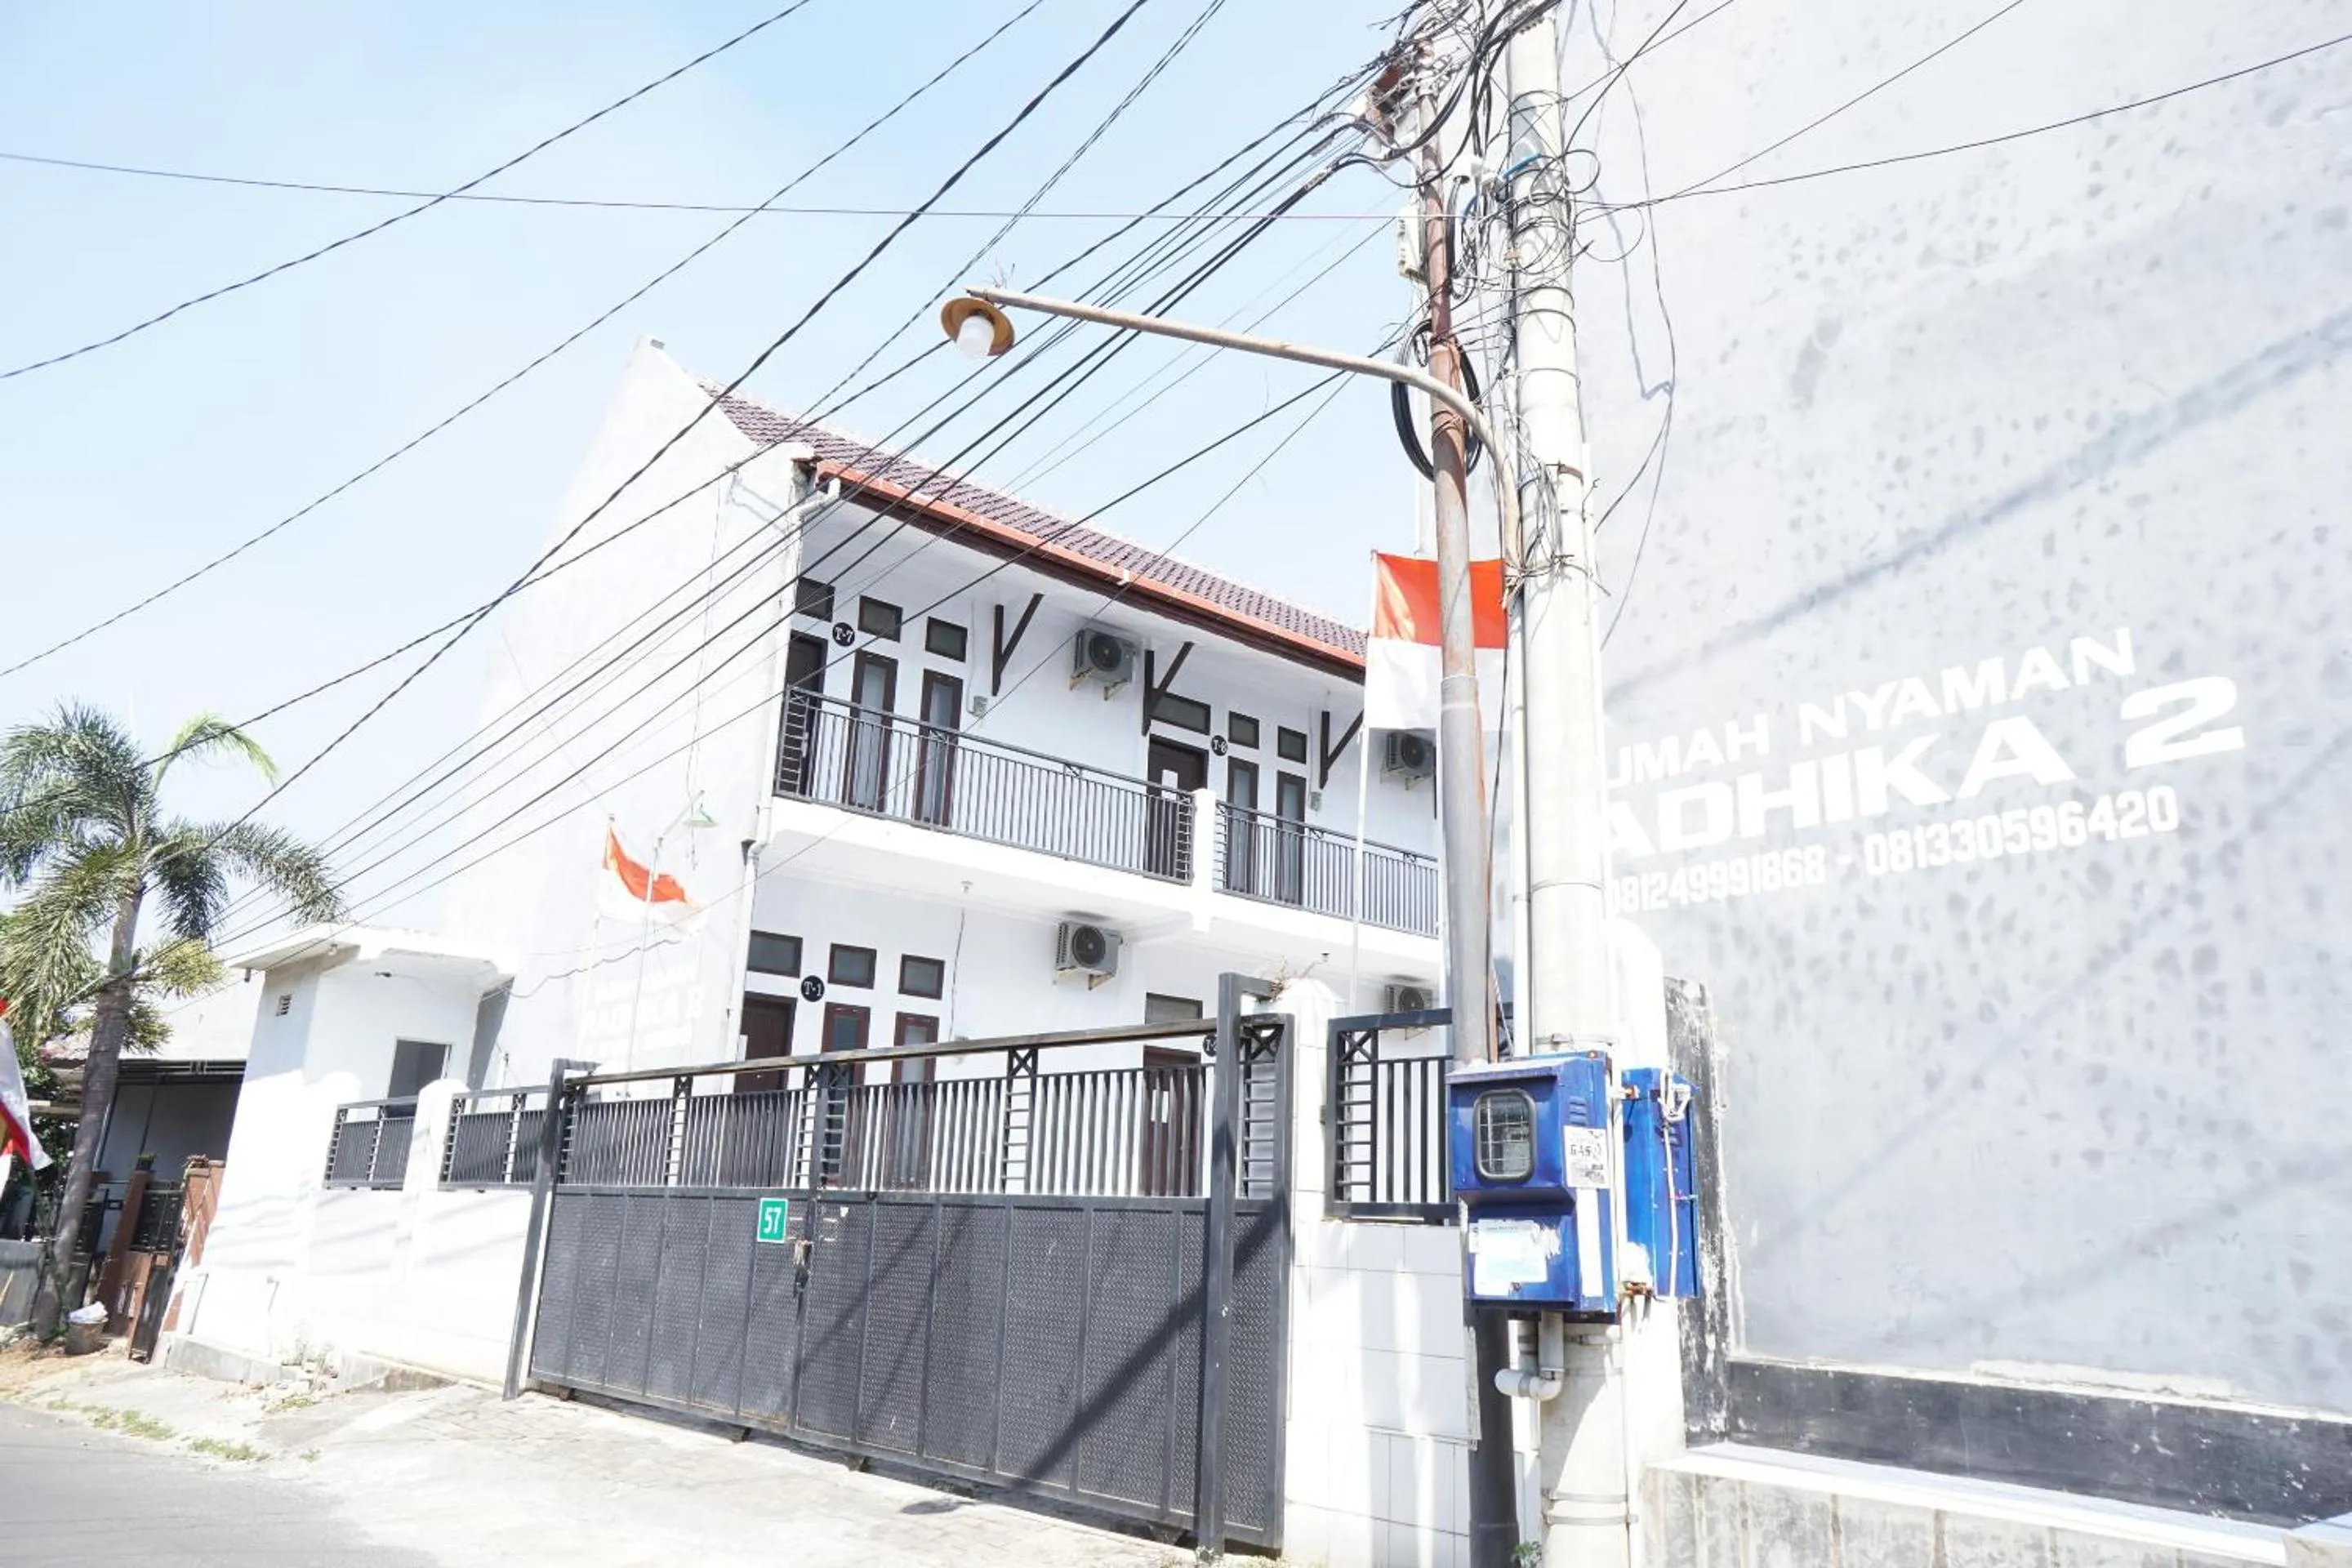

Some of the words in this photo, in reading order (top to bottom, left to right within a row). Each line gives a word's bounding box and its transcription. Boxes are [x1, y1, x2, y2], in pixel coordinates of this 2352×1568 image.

[1605, 712, 1770, 790] UMAH
[1799, 626, 2136, 747] NYAMAN
[1606, 716, 2077, 858] ADHIKA
[2121, 676, 2245, 768] 2
[1865, 786, 2179, 876] 081330596420
[804, 981, 822, 996] T-1
[764, 1206, 782, 1234] 57
